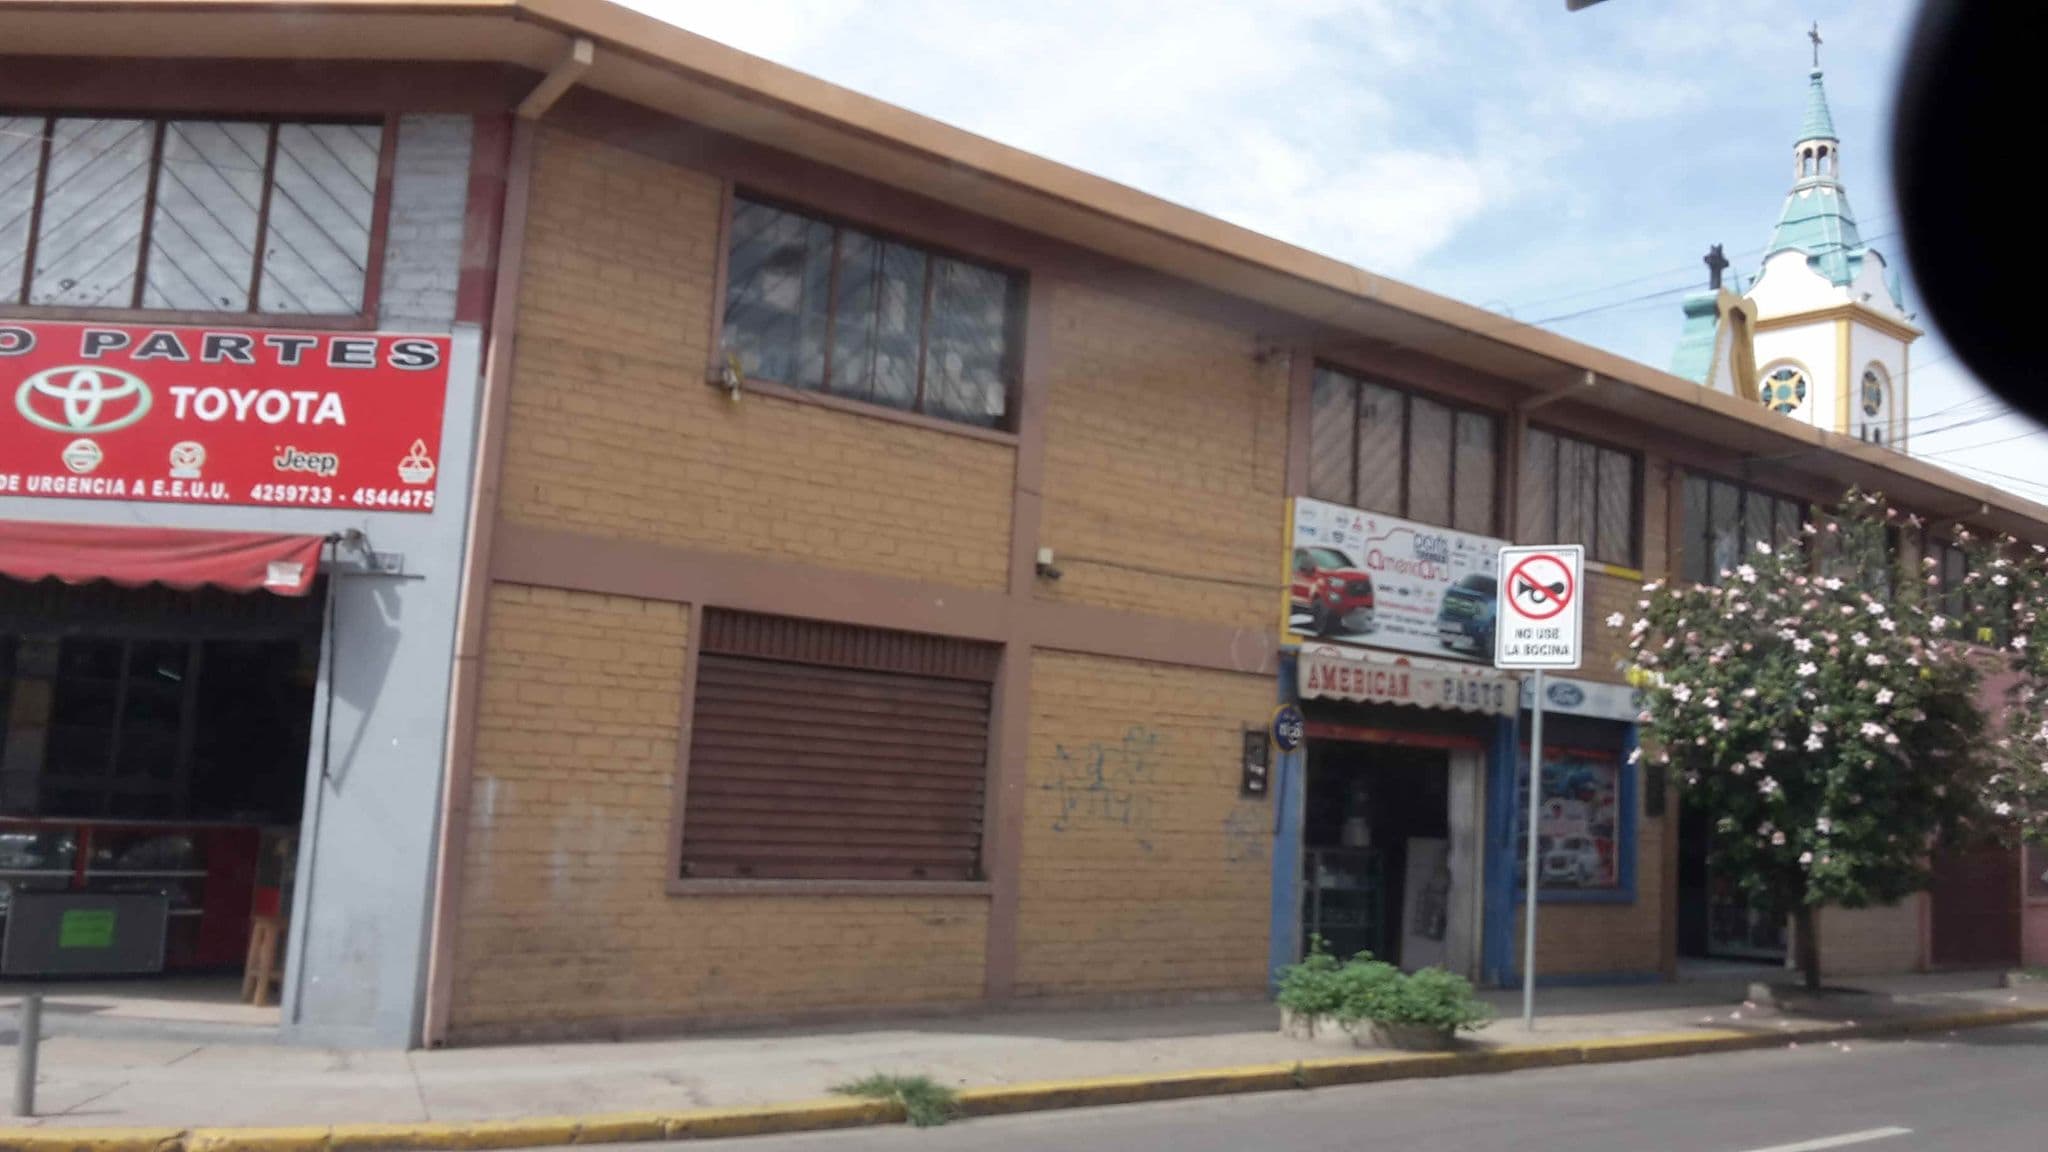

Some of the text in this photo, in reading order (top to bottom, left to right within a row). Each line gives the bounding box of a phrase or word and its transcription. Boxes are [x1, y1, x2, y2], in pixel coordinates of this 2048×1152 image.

[80, 328, 441, 371] PARTES
[169, 386, 346, 425] TOYOTA
[274, 446, 338, 476] Jeep
[27, 475, 126, 496] URGENCIA
[132, 479, 146, 497] A
[152, 480, 230, 499] E.E.U.U.
[250, 483, 332, 504] 4259733
[352, 487, 435, 508] 4544475
[1504, 643, 1569, 656] LA BOCINA
[1514, 628, 1560, 640] NO USE
[1306, 663, 1411, 699] AMERICAN
